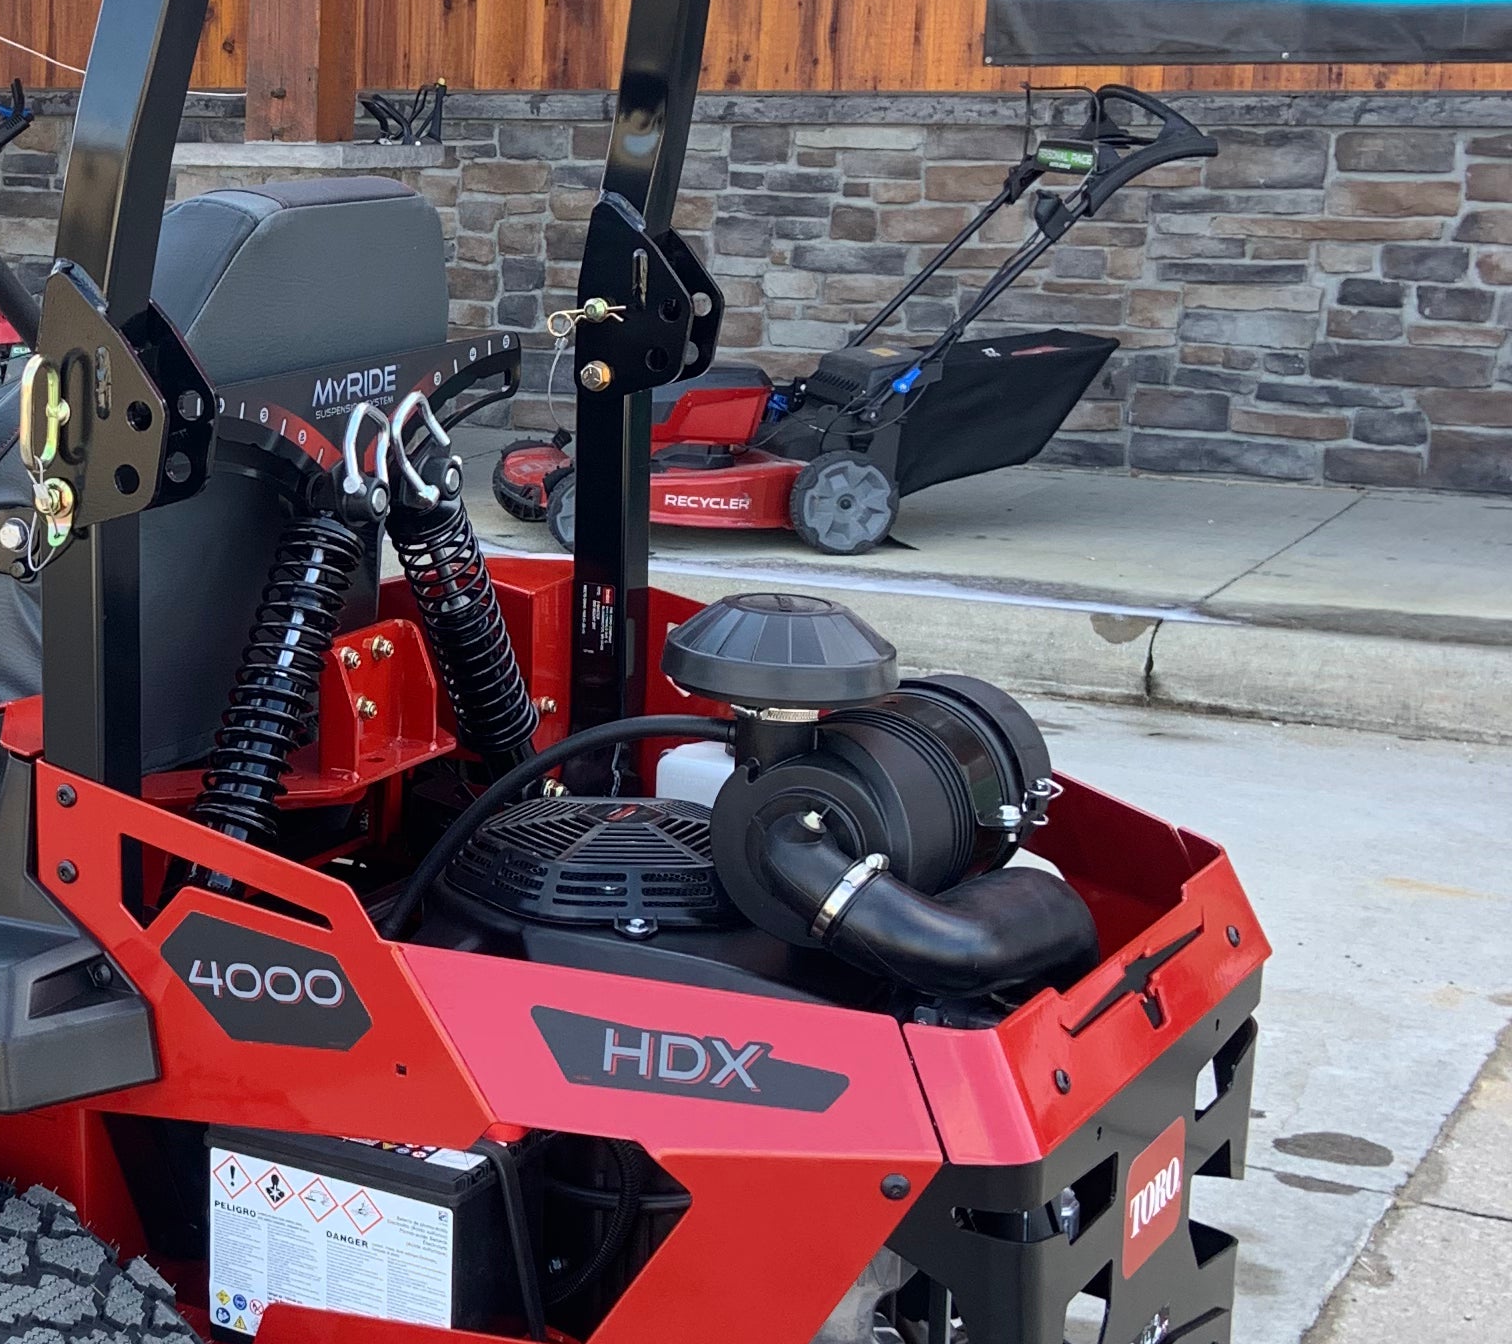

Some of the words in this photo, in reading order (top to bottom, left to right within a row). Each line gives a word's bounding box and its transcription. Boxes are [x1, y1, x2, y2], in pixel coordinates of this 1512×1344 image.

[664, 493, 750, 510] RECYCLER
[188, 957, 346, 1009] 4000
[601, 1026, 765, 1091] HDX
[214, 1200, 257, 1218] PELIGRO
[1128, 1154, 1182, 1239] TORO
[326, 1230, 369, 1249] DANGER
